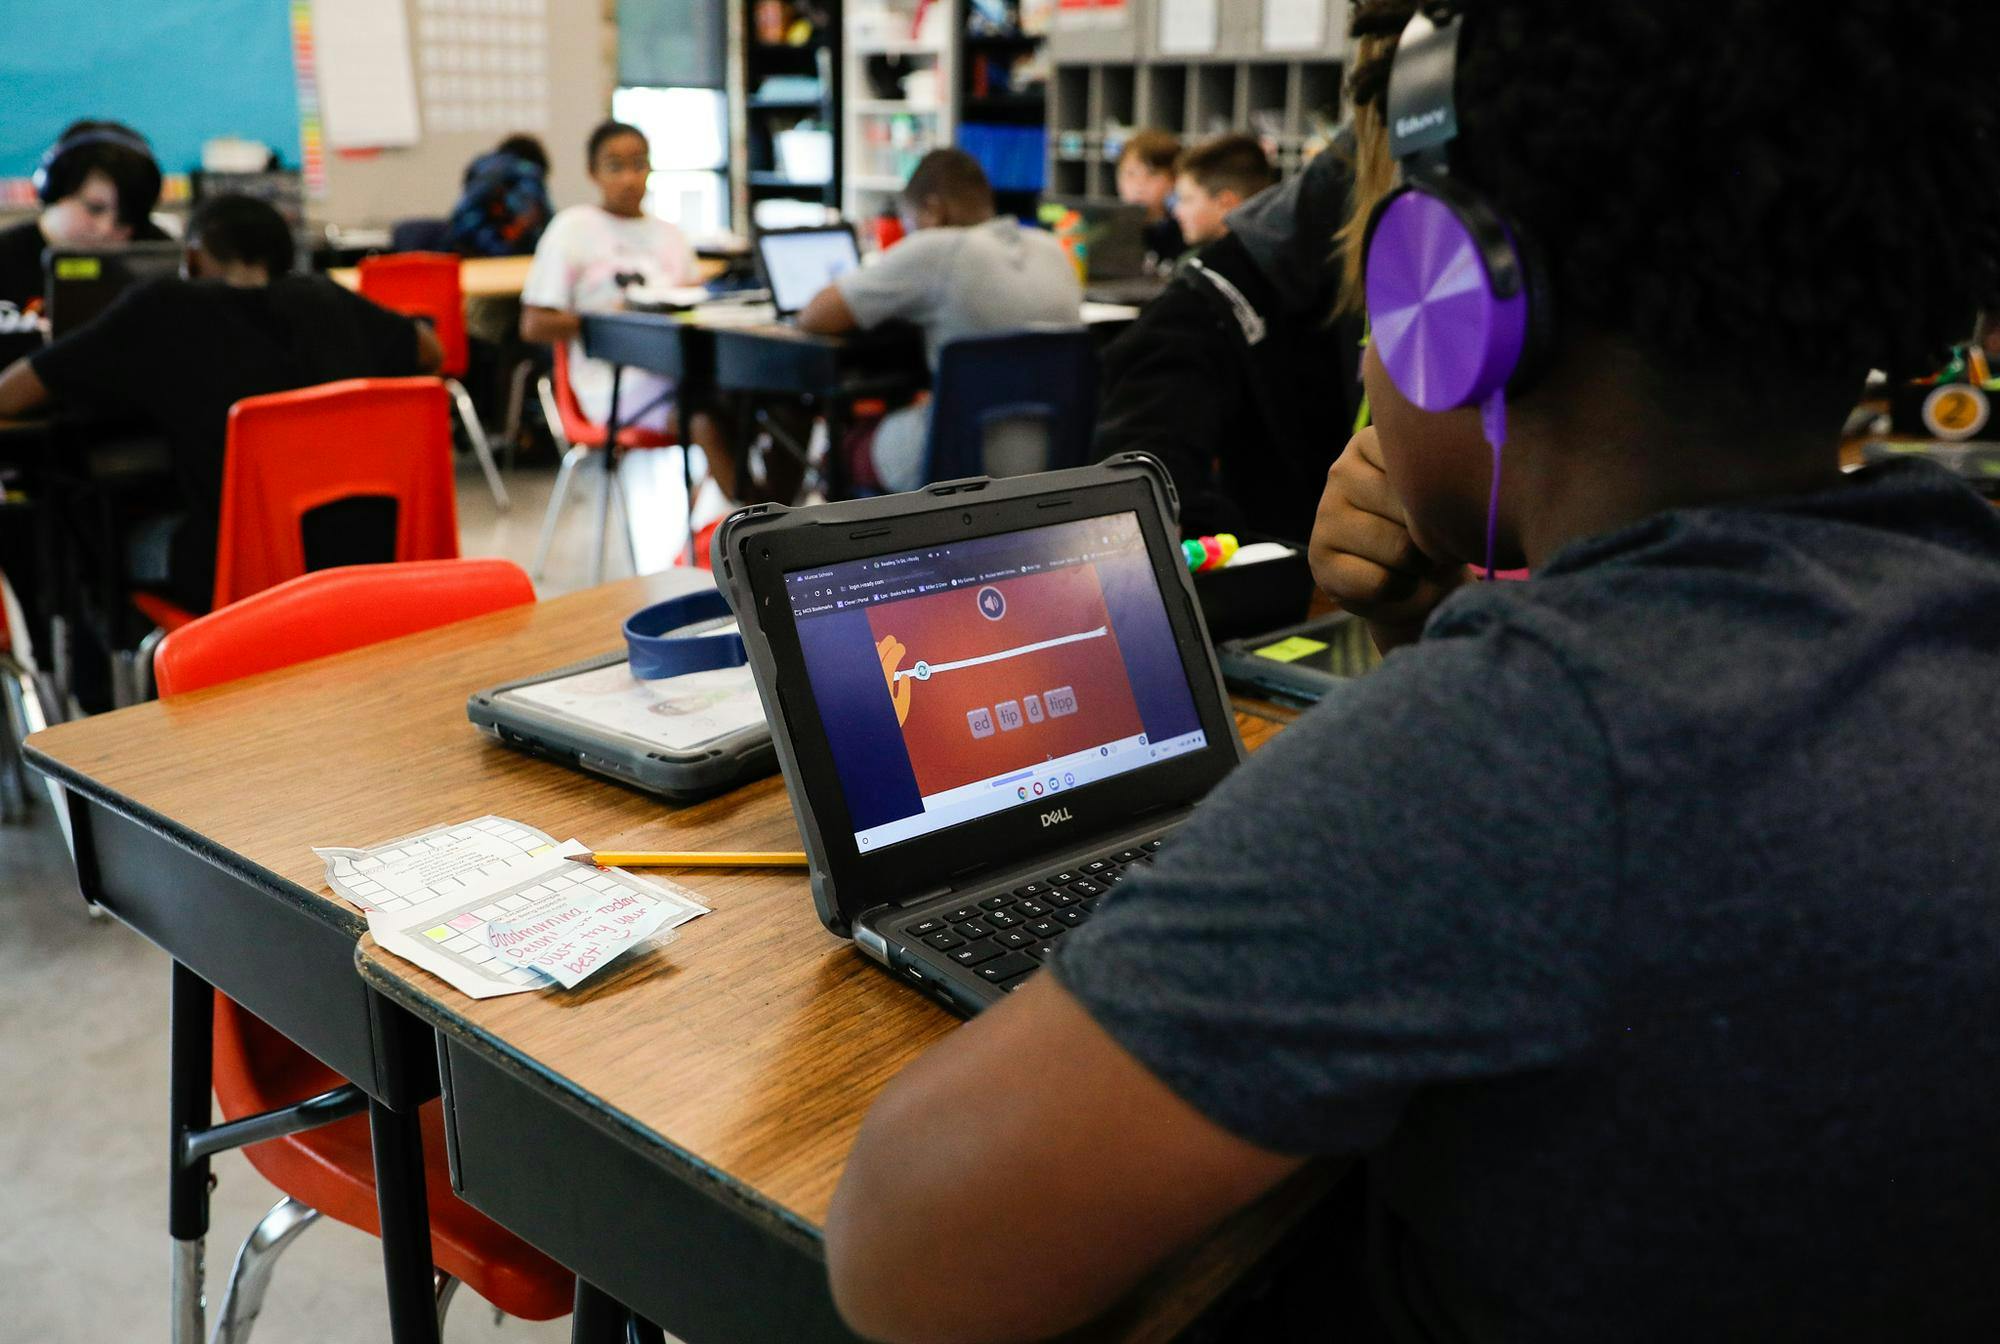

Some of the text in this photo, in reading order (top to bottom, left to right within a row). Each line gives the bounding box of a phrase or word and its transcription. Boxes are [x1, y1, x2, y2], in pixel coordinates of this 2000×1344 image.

[974, 696, 1073, 731] ed tip d tipp
[1040, 807, 1073, 827] DELL
[580, 924, 617, 940] try
[615, 907, 648, 927] your
